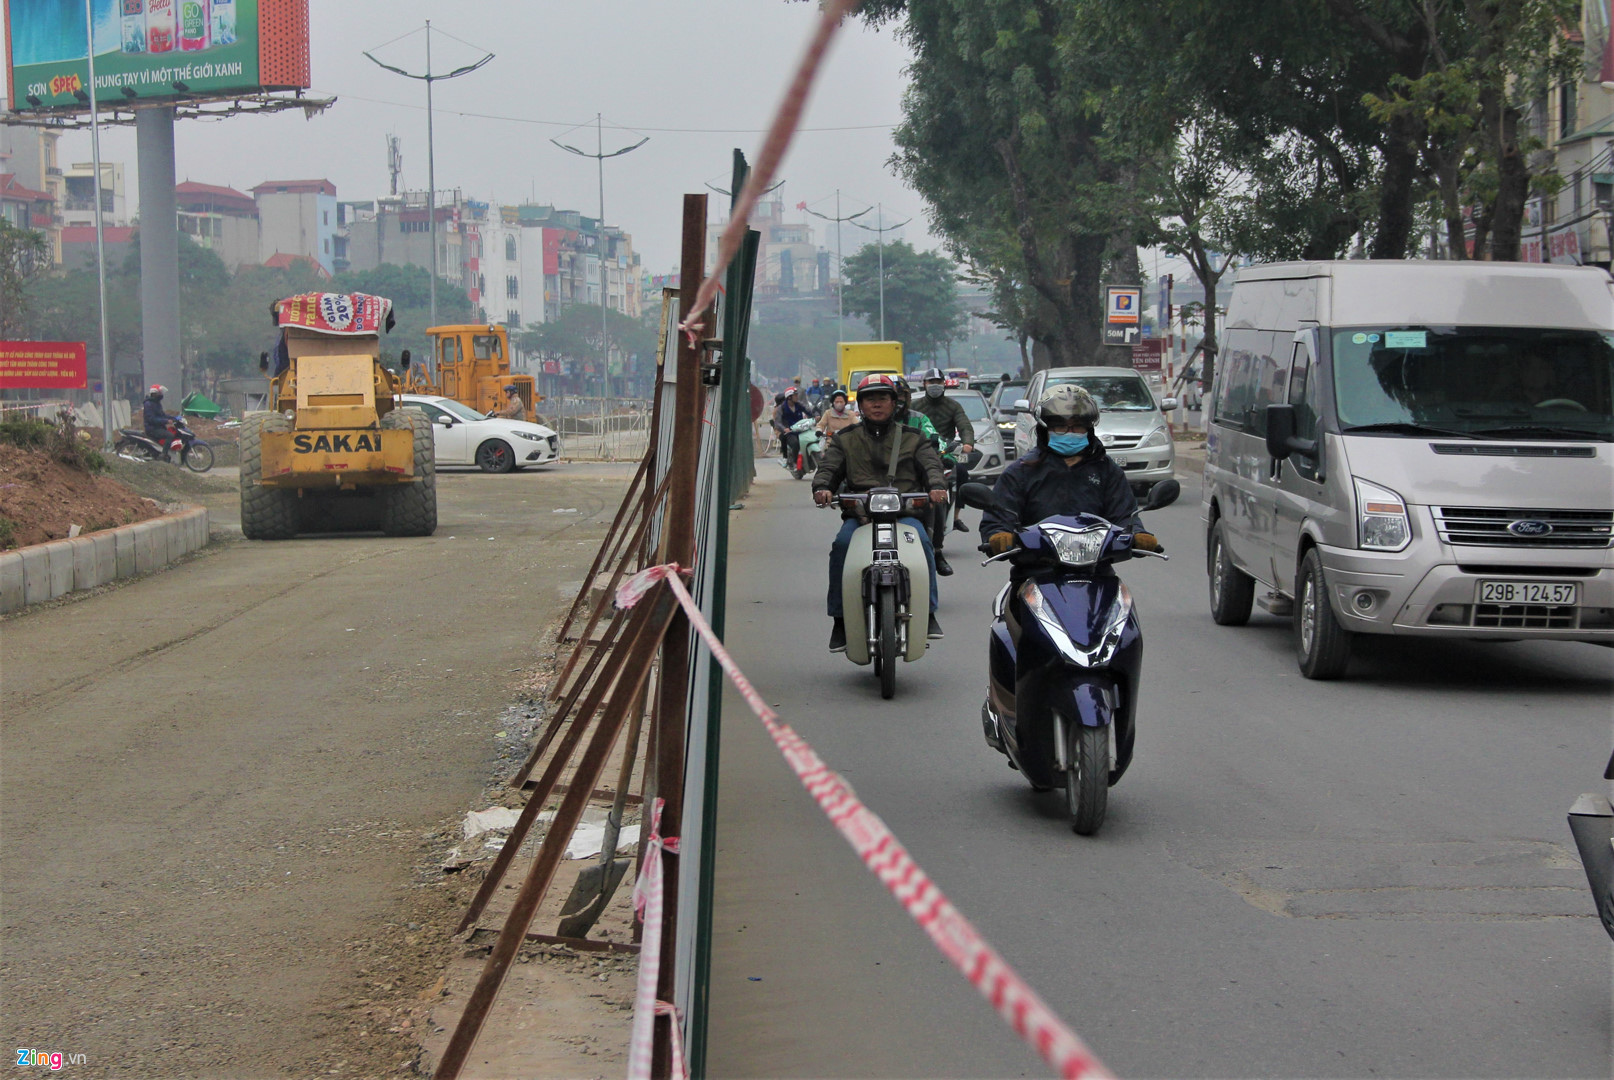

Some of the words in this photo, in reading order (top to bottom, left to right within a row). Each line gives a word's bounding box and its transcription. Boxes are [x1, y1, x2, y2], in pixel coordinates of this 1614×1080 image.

[184, 4, 199, 18] GO
[28, 82, 47, 96] SƠN
[53, 76, 77, 93] SPEC
[122, 71, 139, 86] TAY
[141, 68, 150, 84] VÌ
[151, 66, 172, 85] MỘT
[173, 62, 192, 81] THẾ
[193, 62, 213, 79] GIỚI
[215, 62, 242, 77] XANH
[293, 434, 381, 454] SAKAI
[1517, 521, 1543, 533] Ford
[1484, 583, 1573, 602] 29B-124.57
